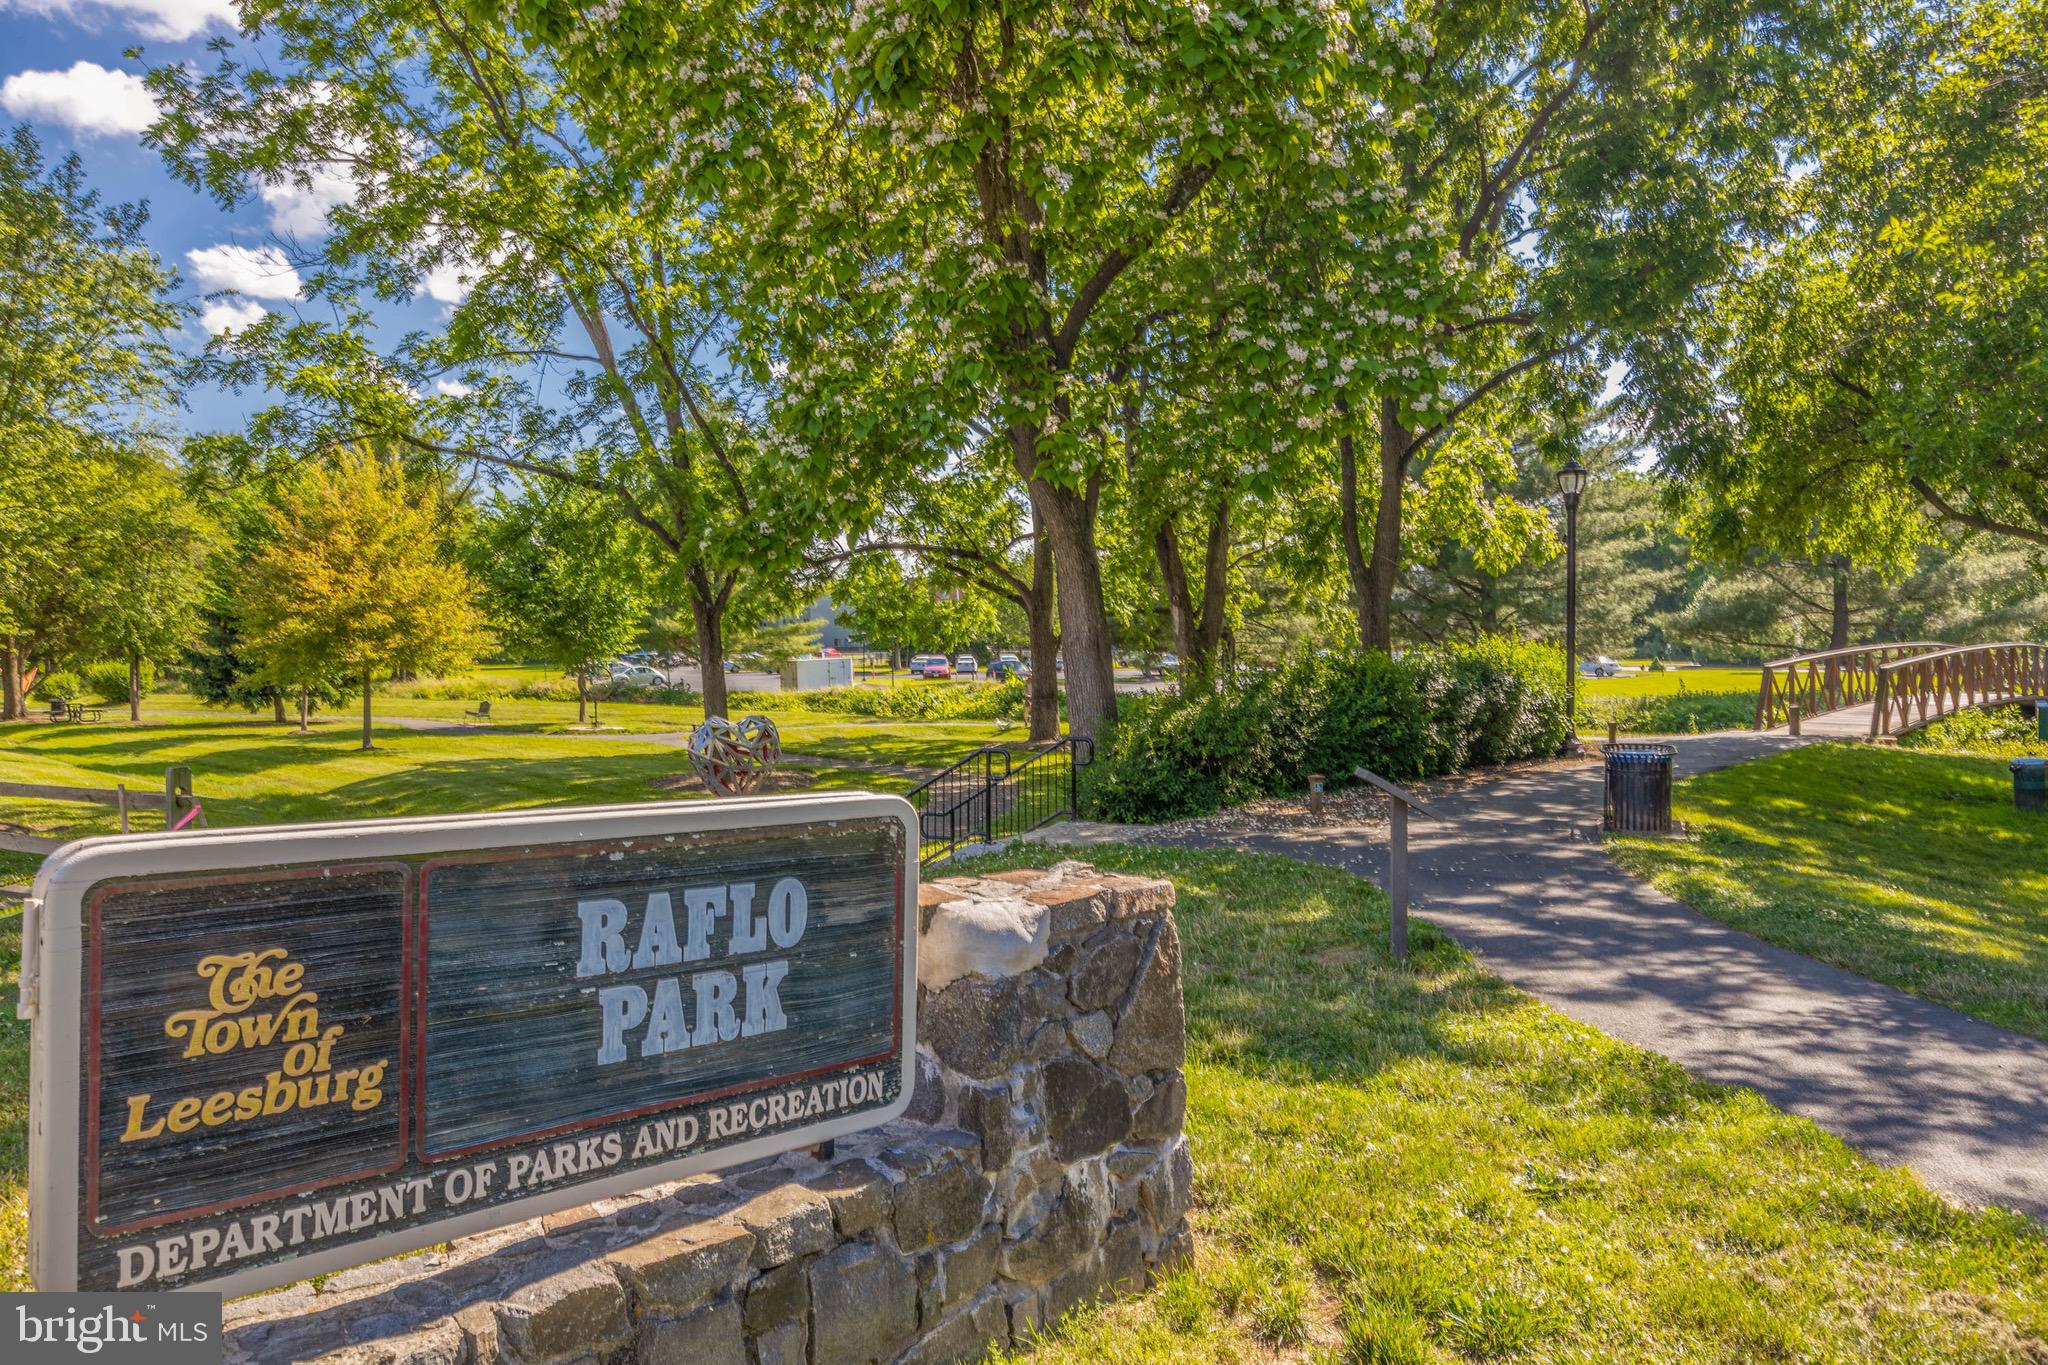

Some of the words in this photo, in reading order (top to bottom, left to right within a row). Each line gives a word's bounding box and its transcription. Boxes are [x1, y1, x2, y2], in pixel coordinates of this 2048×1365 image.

[576, 876, 808, 978] RAFLO
[196, 947, 305, 1014] The
[597, 959, 789, 1066] PARK
[164, 991, 319, 1059] Town
[282, 1025, 345, 1077] of
[119, 1058, 390, 1143] Leesburg
[116, 1177, 434, 1289] DEPARTMENT
[444, 1161, 498, 1205] OF
[507, 1131, 623, 1191] PARKS
[631, 1115, 699, 1160] AND
[708, 1070, 885, 1140] RECREATION
